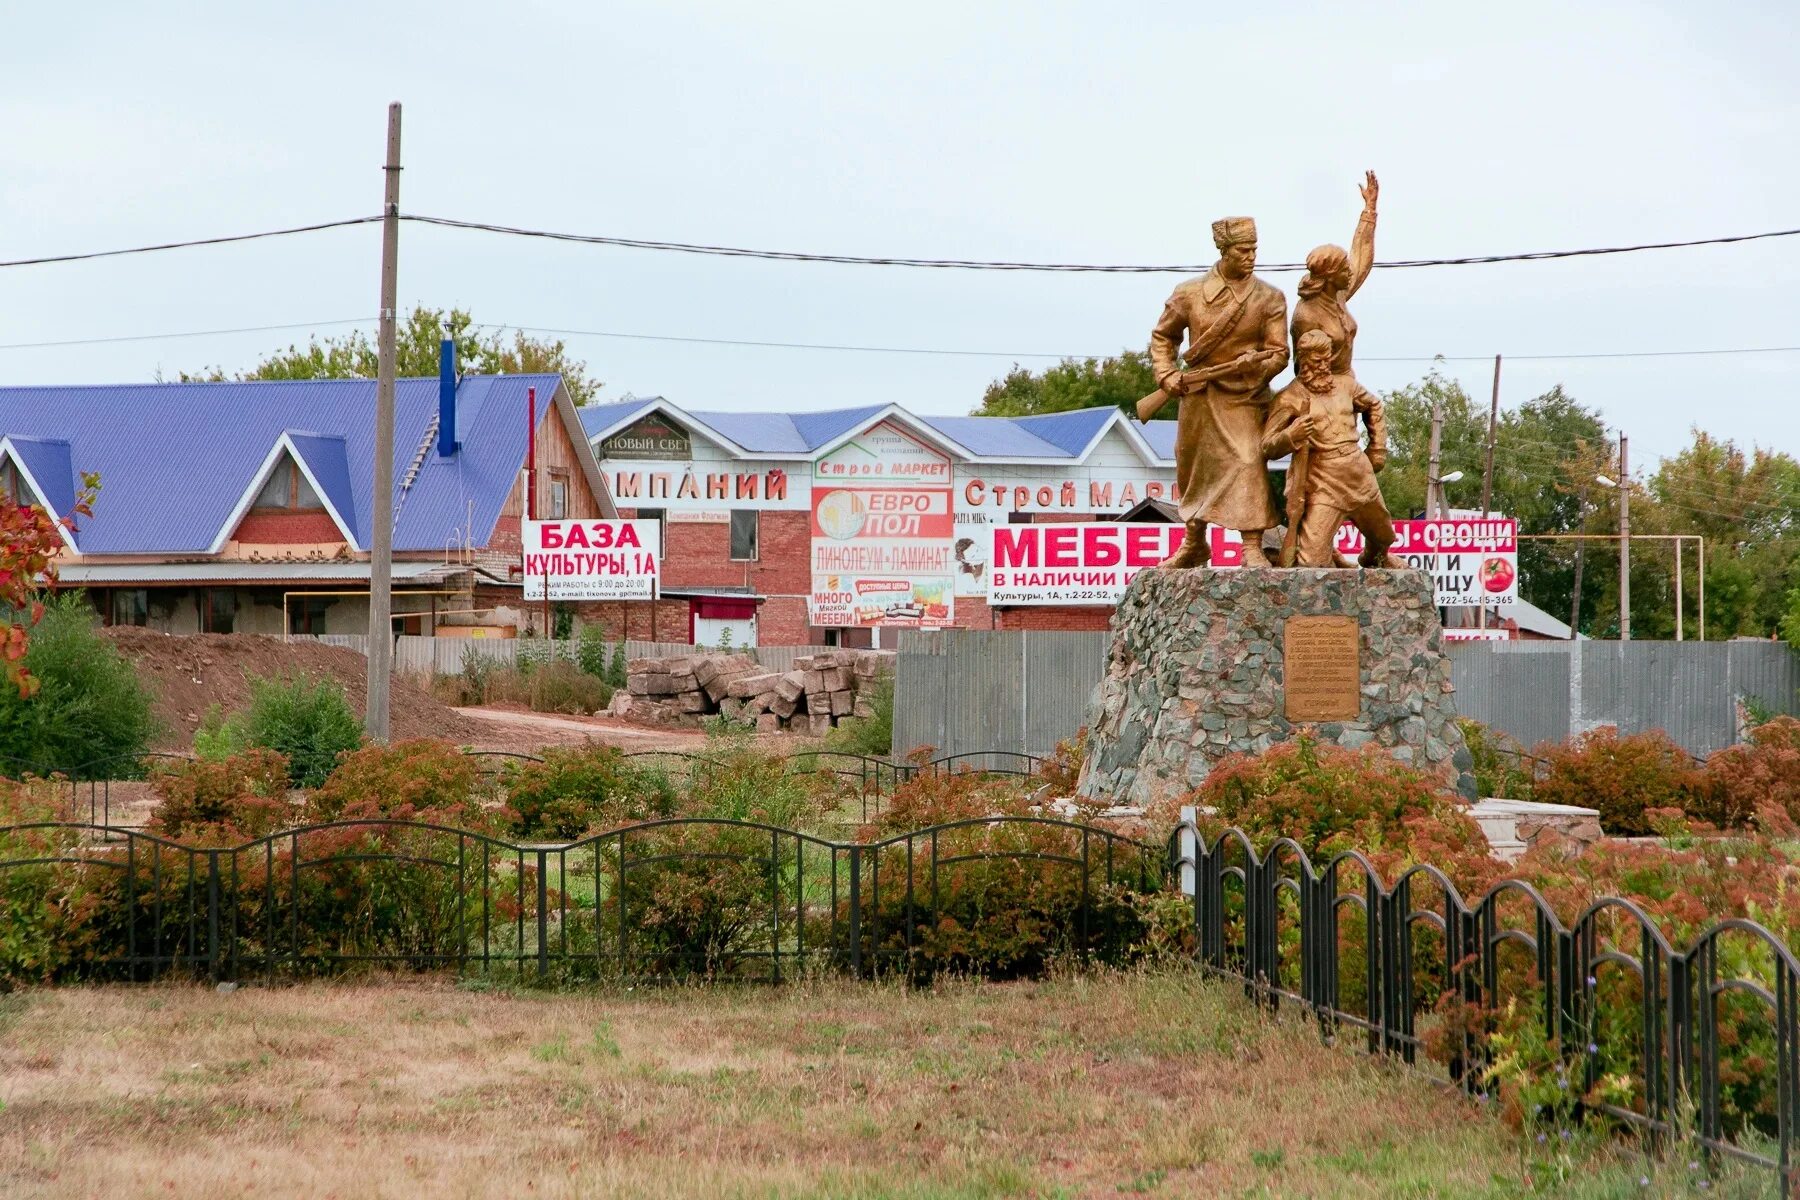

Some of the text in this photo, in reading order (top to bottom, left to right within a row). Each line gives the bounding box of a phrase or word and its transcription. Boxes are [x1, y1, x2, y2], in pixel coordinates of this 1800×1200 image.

[608, 437, 689, 450] НОВЫЙ СВЕТ
[891, 463, 947, 476] МАРКЕТ
[602, 468, 788, 501] МПАНИЙ
[868, 494, 931, 512] ЕВРО
[865, 514, 921, 535] ПОЛ
[541, 523, 642, 549] БАЗА
[1423, 523, 1512, 551] ОВОЩИ
[526, 553, 656, 577] КУЛЬТУРЫ, 1А
[816, 547, 950, 571] ЛИНОЛЕУМ ЛАМИНАТ
[1447, 554, 1460, 571] И
[562, 580, 590, 588] РАБОТЫ
[598, 579, 613, 588] 9:00
[625, 579, 645, 588] 20:00
[994, 573, 1006, 586] В
[1013, 572, 1116, 586] НАЛИЧИИ
[814, 592, 853, 604] МНОГО
[993, 591, 1044, 601] Культуры,
[1047, 592, 1063, 600] 1А,
[1065, 591, 1111, 600] т.2-22-52,
[814, 613, 853, 625] МЕБЕЛИ
